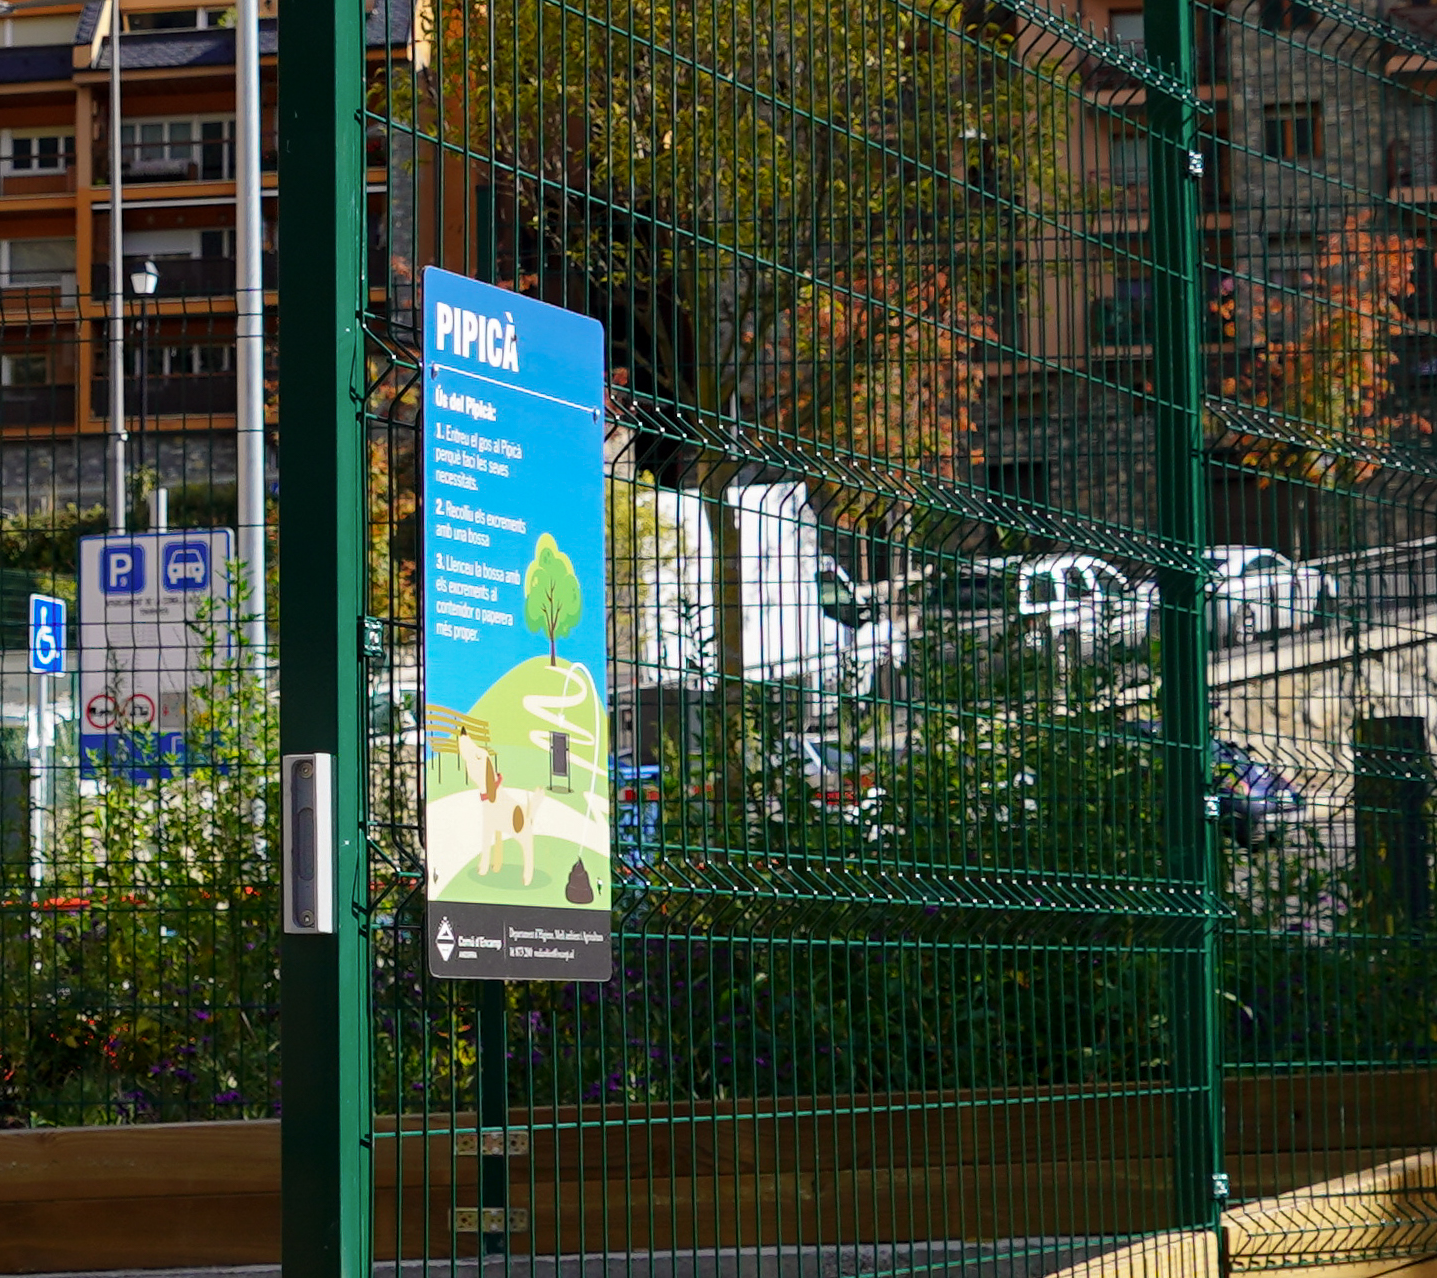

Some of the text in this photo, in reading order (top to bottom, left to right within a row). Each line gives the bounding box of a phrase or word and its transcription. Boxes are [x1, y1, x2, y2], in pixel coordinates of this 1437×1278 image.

[436, 301, 520, 373] PIPICÀ
[435, 384, 497, 422] Ús del Pipicà:
[436, 422, 523, 460] 1. Entreu el gos al Pipicà
[435, 447, 510, 478] perquè faci les seves
[436, 469, 479, 492] necessitats.
[435, 497, 445, 516] 2.
[474, 508, 486, 524] els
[486, 513, 527, 535] excrements
[435, 522, 490, 547] amb una bossa
[435, 552, 521, 586] 3. Llenceu la bossa amb
[435, 576, 498, 603] els excrements al
[435, 601, 514, 627] contenidor o paperera
[435, 621, 453, 639] més
